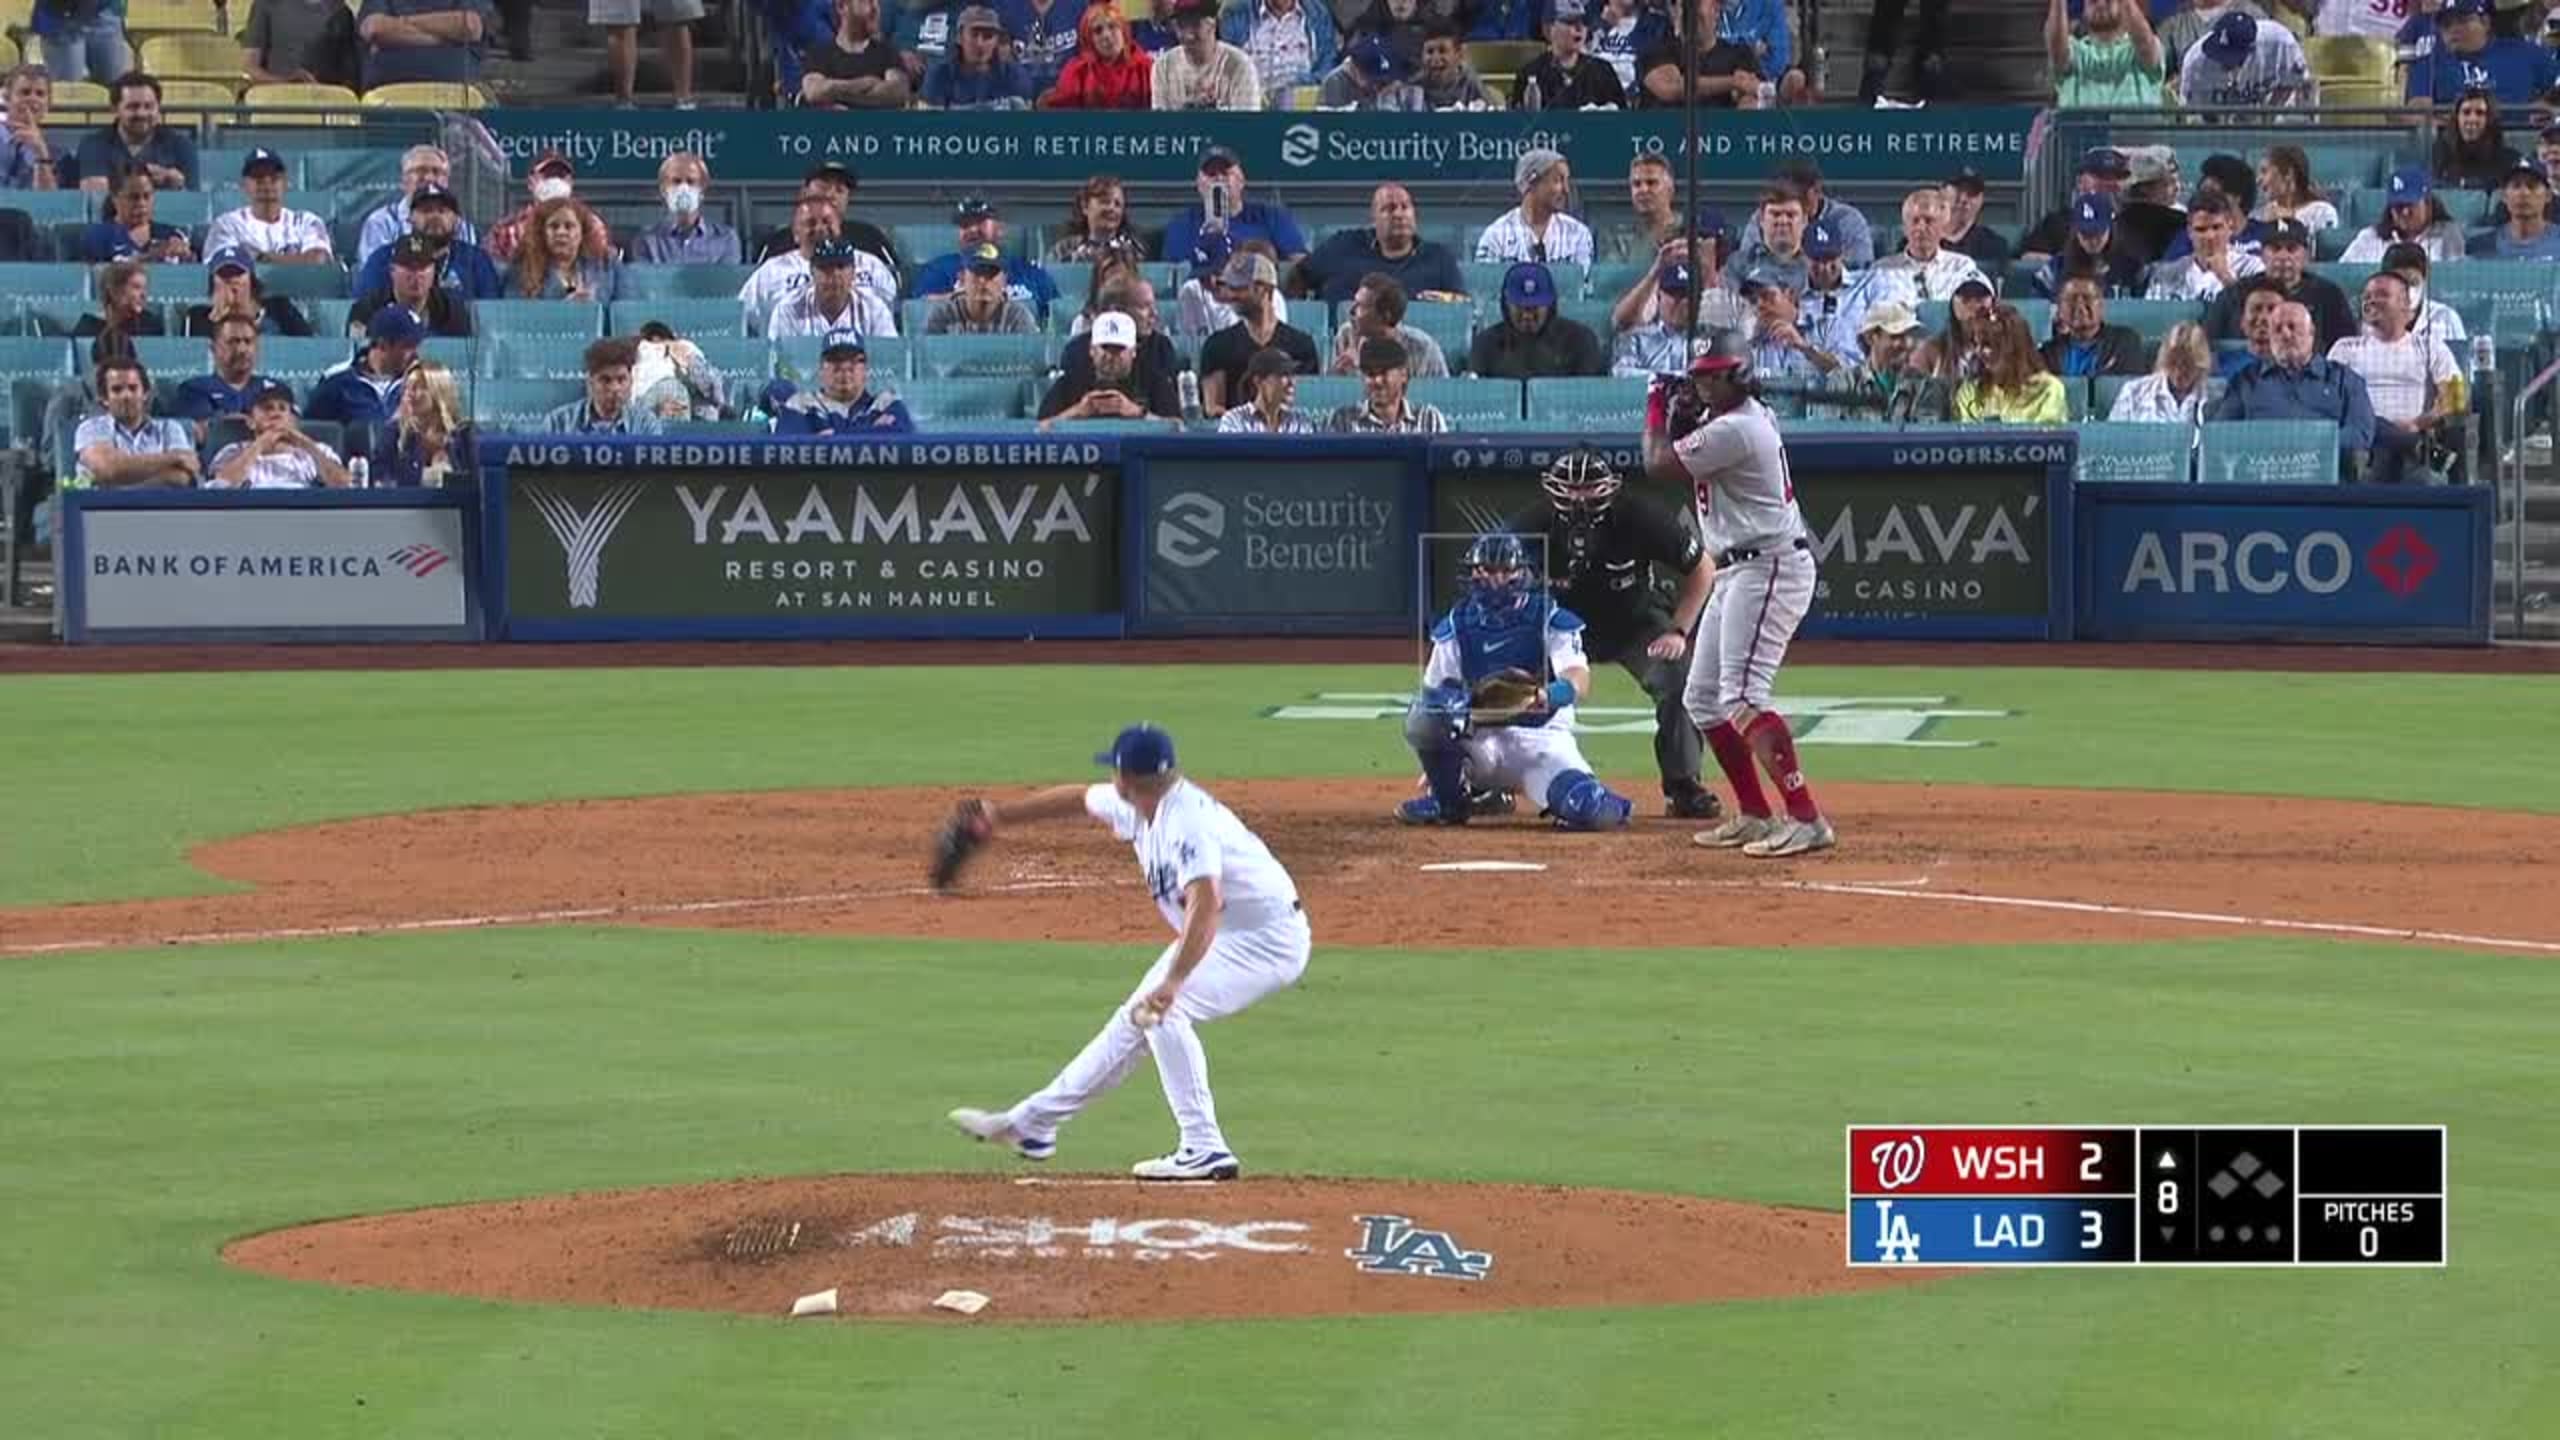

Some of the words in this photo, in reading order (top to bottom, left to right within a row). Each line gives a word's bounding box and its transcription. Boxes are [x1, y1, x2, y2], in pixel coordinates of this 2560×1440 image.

[611, 130, 717, 159] Benefit
[779, 135, 812, 155] TO
[826, 135, 879, 155] AND
[893, 135, 1019, 156] THROUGH
[1034, 135, 1202, 156] RETIREMENT
[1328, 130, 1451, 168] Security
[1459, 130, 1560, 160] Benefit
[1631, 135, 1665, 155] TO
[1745, 133, 1872, 154] THROUGH
[1887, 132, 2022, 153] RETIREME
[506, 446, 570, 466] AUG
[582, 446, 623, 466] 10:
[635, 445, 751, 466] FREDDIE
[763, 445, 899, 466] FREEMAN
[911, 444, 1101, 466] BOBBLEHEAD
[1893, 446, 2067, 464] DODGERS.COM
[675, 473, 1101, 546] YAAMAVA'
[1242, 490, 1393, 535] Security
[1247, 533, 1373, 569] Benefit
[2123, 530, 2353, 594] ARCO
[94, 554, 179, 577] BANK
[191, 555, 228, 577] OF
[237, 555, 381, 577] AMERICA
[725, 559, 857, 579] RESORT
[880, 559, 896, 578] &
[918, 559, 1044, 579] CASINO
[776, 590, 805, 607] AT
[822, 590, 872, 607] SAN
[888, 590, 996, 607] MANUEL
[1855, 580, 1983, 600] CASINO
[1344, 1213, 1494, 1281] LA
